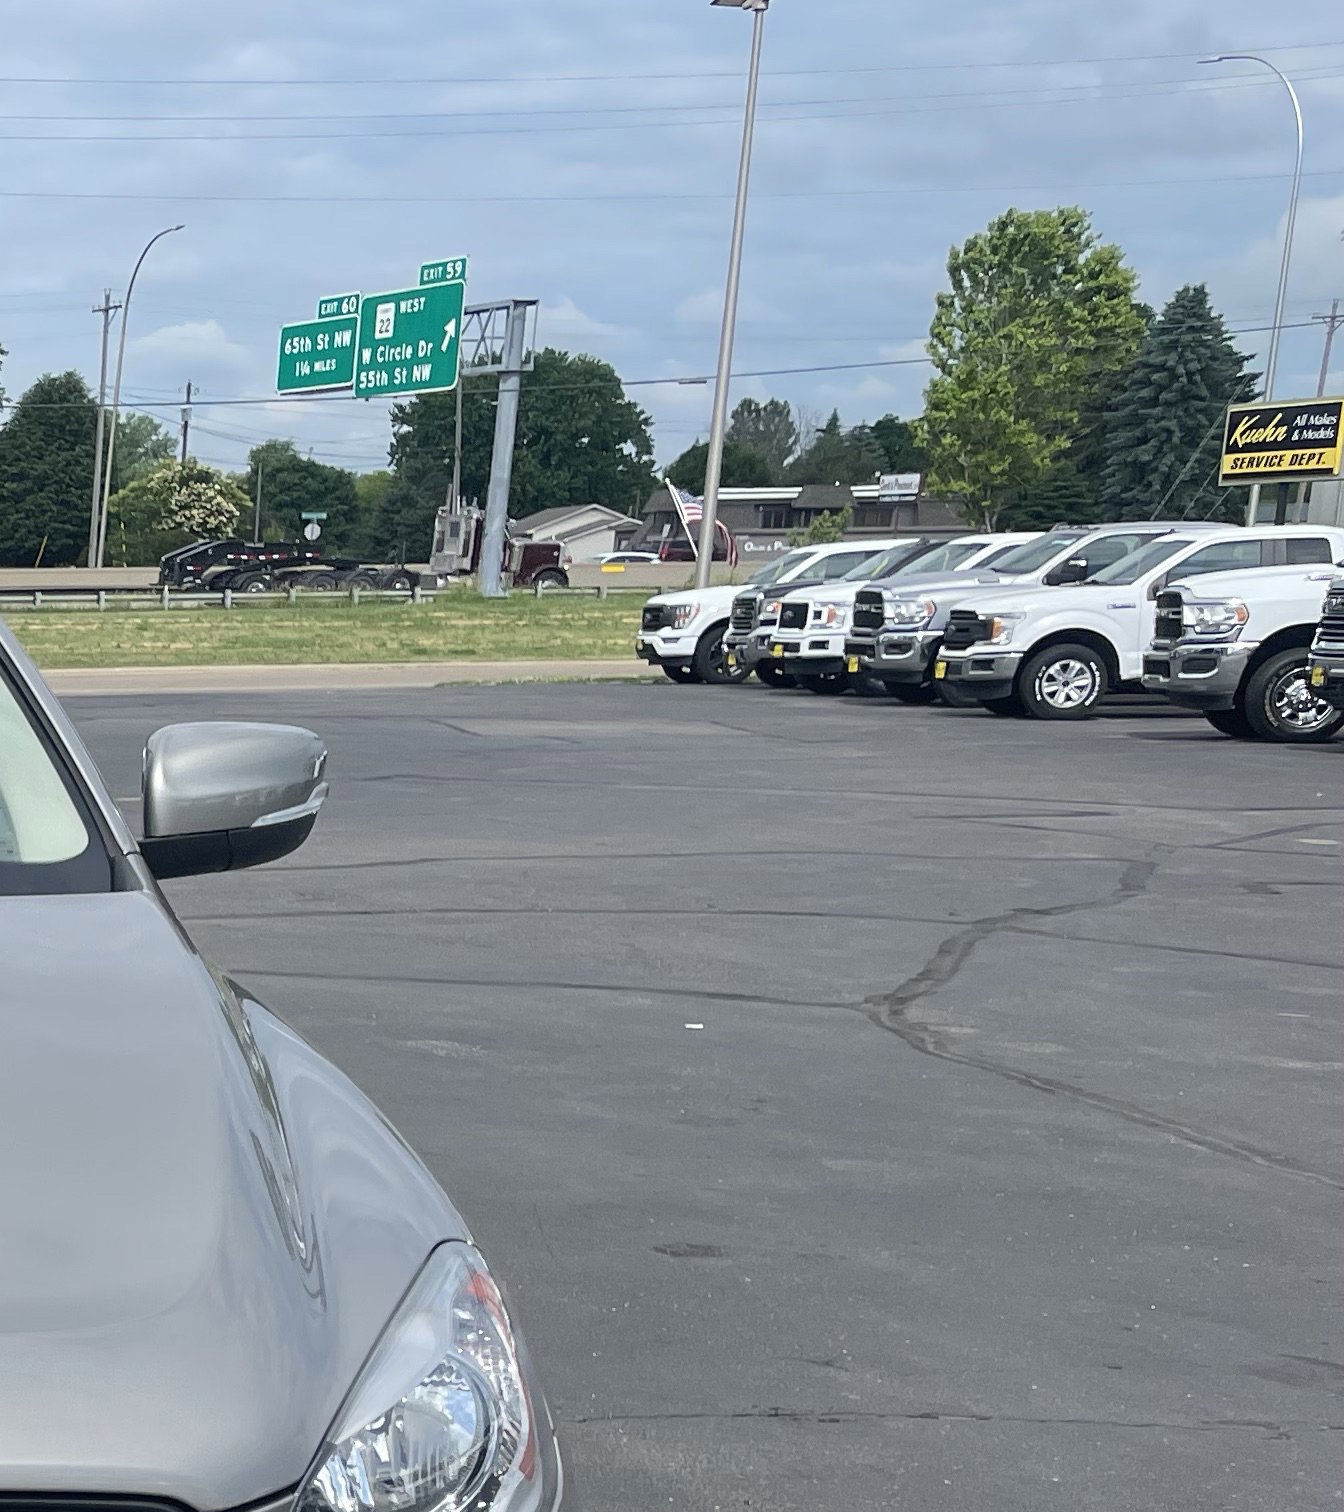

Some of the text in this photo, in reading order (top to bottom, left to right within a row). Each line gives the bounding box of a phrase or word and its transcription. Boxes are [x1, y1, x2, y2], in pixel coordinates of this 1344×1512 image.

[423, 261, 462, 281] EXIT 59
[321, 297, 357, 315] EXIT 60
[400, 297, 426, 313] WEST
[379, 317, 391, 334] 22
[284, 329, 352, 355] 65th St NW
[362, 339, 433, 365] W Circle Dr
[314, 358, 337, 372] MILES
[359, 363, 432, 389] 55th St NW
[1293, 412, 1338, 427] All Makes
[1229, 412, 1288, 449] Kuehn
[1291, 426, 1335, 441] & Models
[1231, 451, 1328, 470] SERVICE DEPT.
